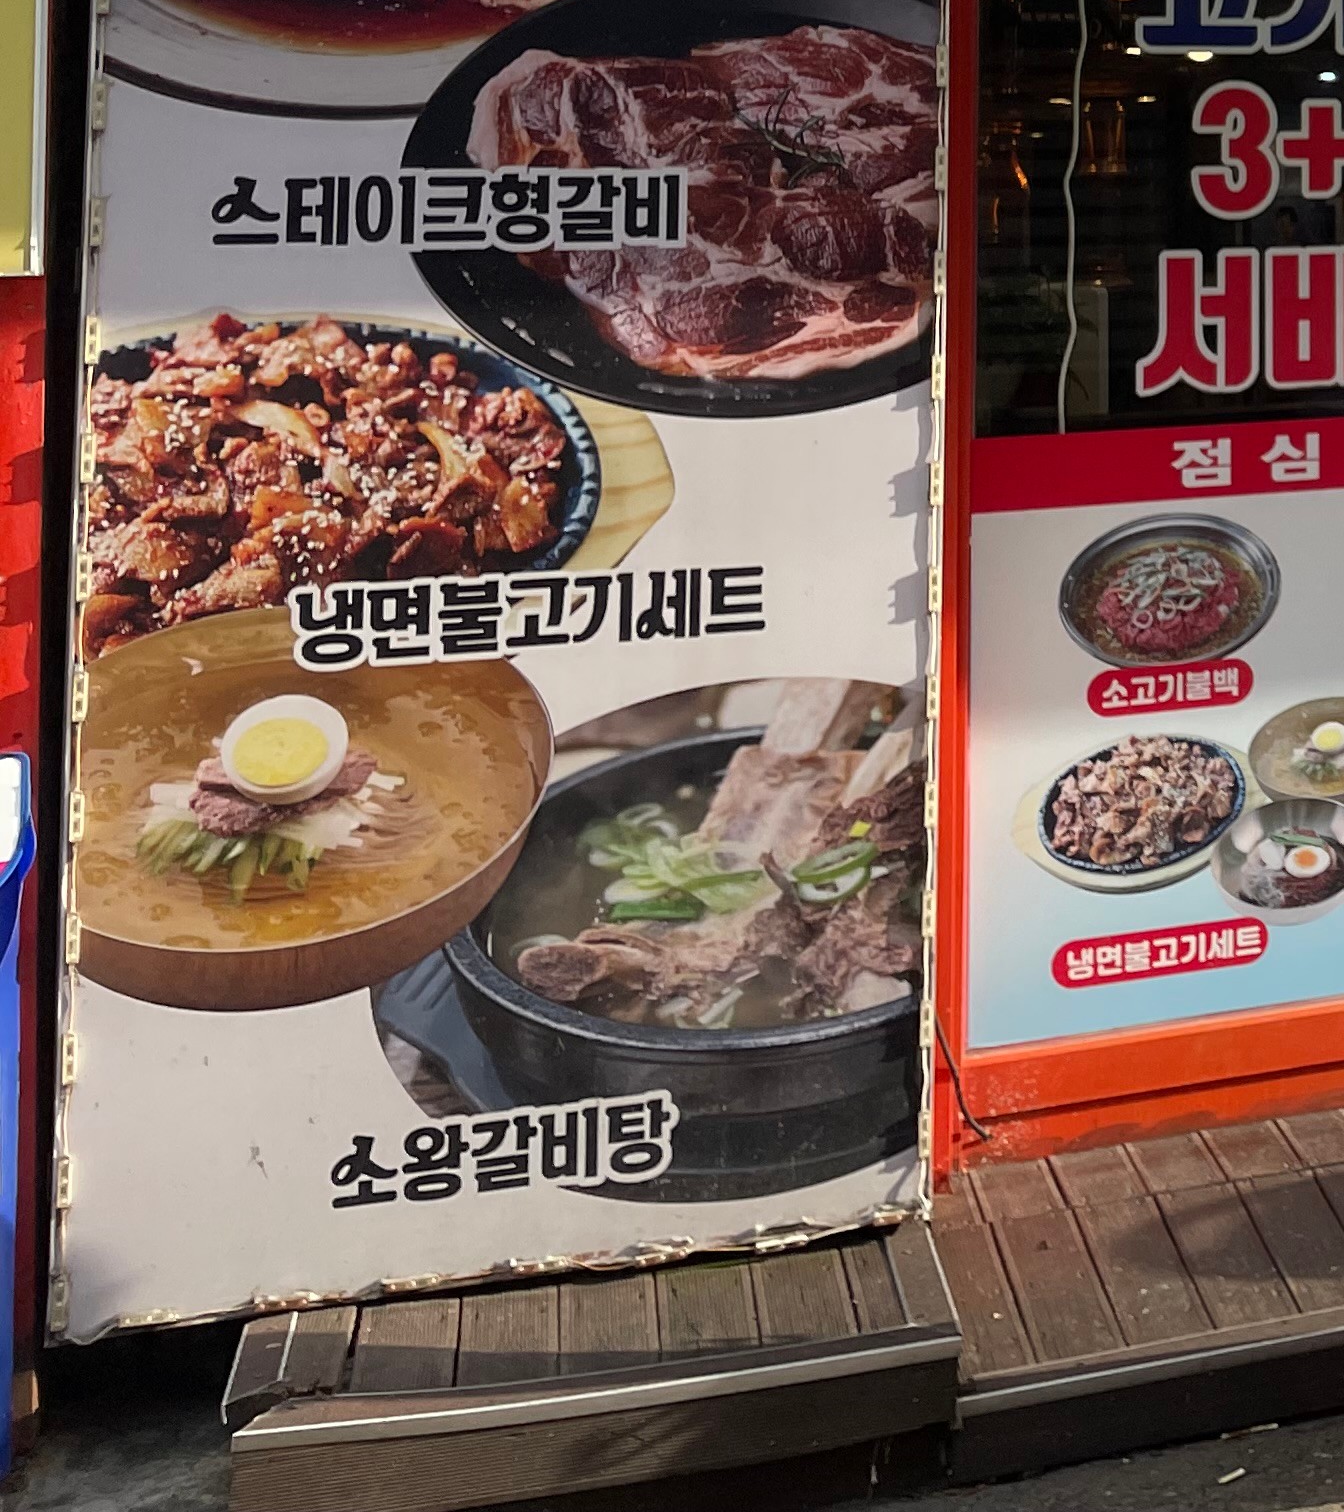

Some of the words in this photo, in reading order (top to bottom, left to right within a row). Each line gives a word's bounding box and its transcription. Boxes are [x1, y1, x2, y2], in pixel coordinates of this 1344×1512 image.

[211, 173, 682, 247] 스테이크형갈비
[293, 566, 765, 666] 냉면불고기세트
[1100, 666, 1241, 709] 소고기불백
[1065, 925, 1263, 980] 냉면불고기세트
[330, 1097, 674, 1209] 소왕갈비탕
